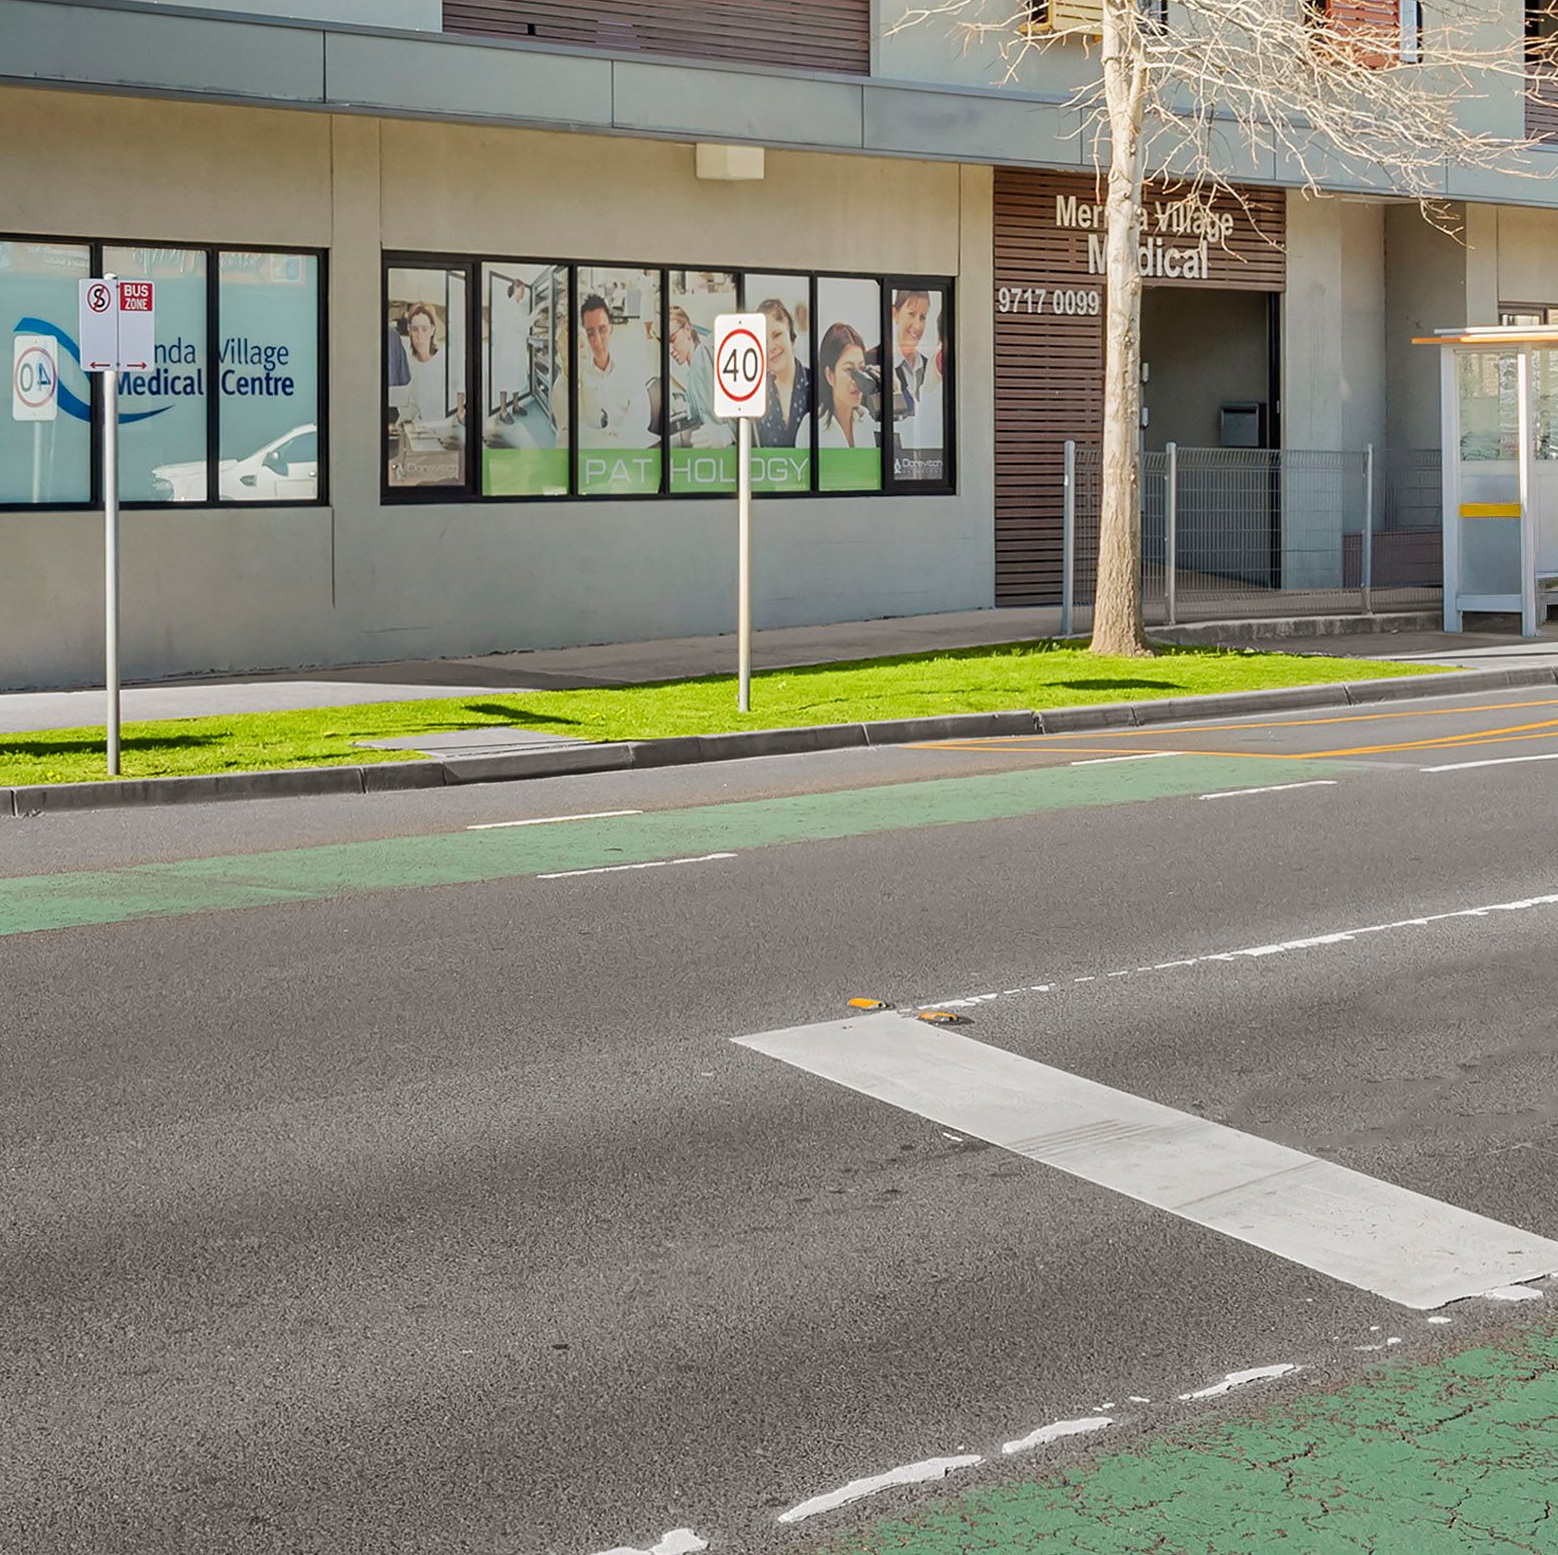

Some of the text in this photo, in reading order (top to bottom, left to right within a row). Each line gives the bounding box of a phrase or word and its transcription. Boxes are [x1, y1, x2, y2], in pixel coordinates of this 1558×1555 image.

[1155, 201, 1234, 242] Village
[1088, 234, 1208, 279] Mdical
[124, 284, 148, 297] BUS
[125, 298, 148, 310] ZONE
[998, 287, 1099, 315] 9717 0099
[723, 348, 758, 382] 40
[222, 369, 294, 395] Centre
